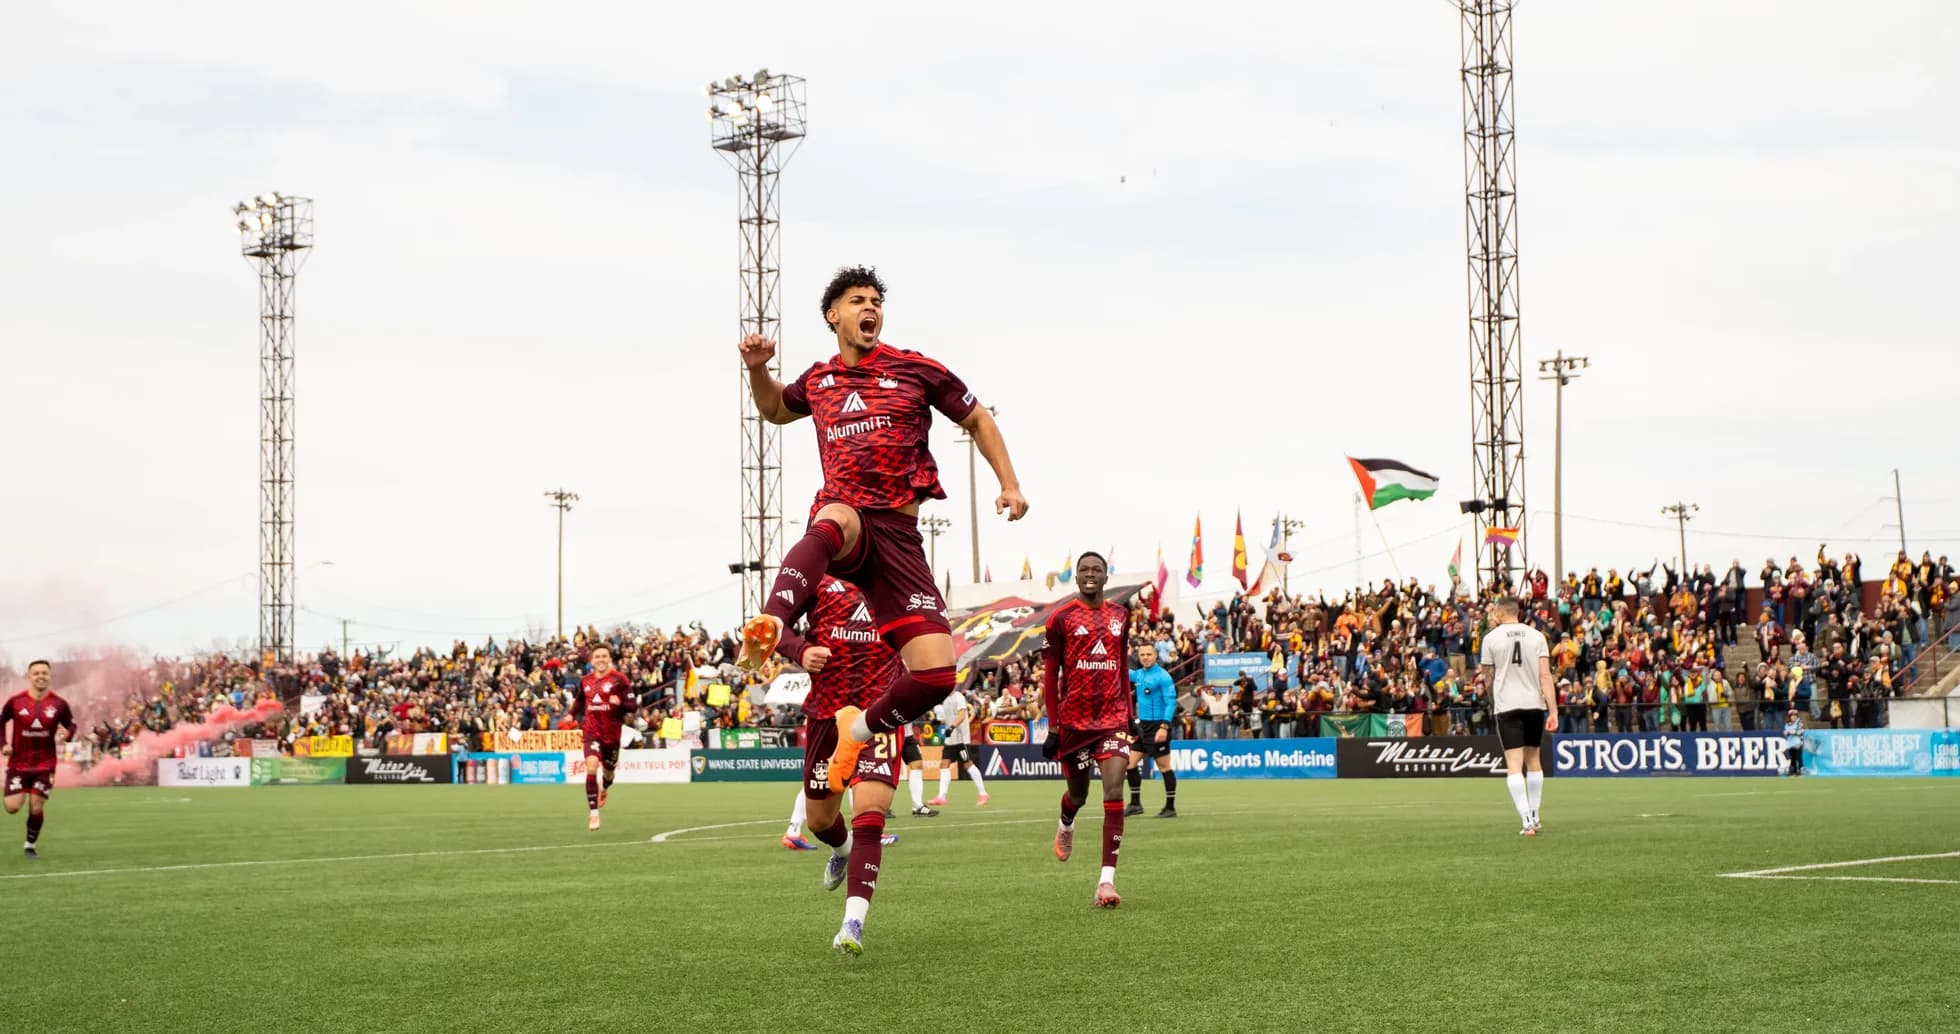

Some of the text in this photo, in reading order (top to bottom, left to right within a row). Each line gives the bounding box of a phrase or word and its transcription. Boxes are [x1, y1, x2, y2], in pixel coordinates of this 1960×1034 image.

[782, 567, 808, 588] DCFC
[1512, 641, 1522, 667] 4
[873, 734, 897, 759] 21
[1557, 735, 1791, 772] STROH'S BEER
[1831, 735, 1920, 751] FINLAND'S BEST
[708, 759, 805, 769] WAYNE STATE UNIVERSIT
[1212, 751, 1261, 771] Sports
[1265, 750, 1335, 767] Medicine
[1367, 742, 1509, 773] Motor City
[1395, 764, 1446, 772] CASINO
[1832, 751, 1860, 768] KEPT
